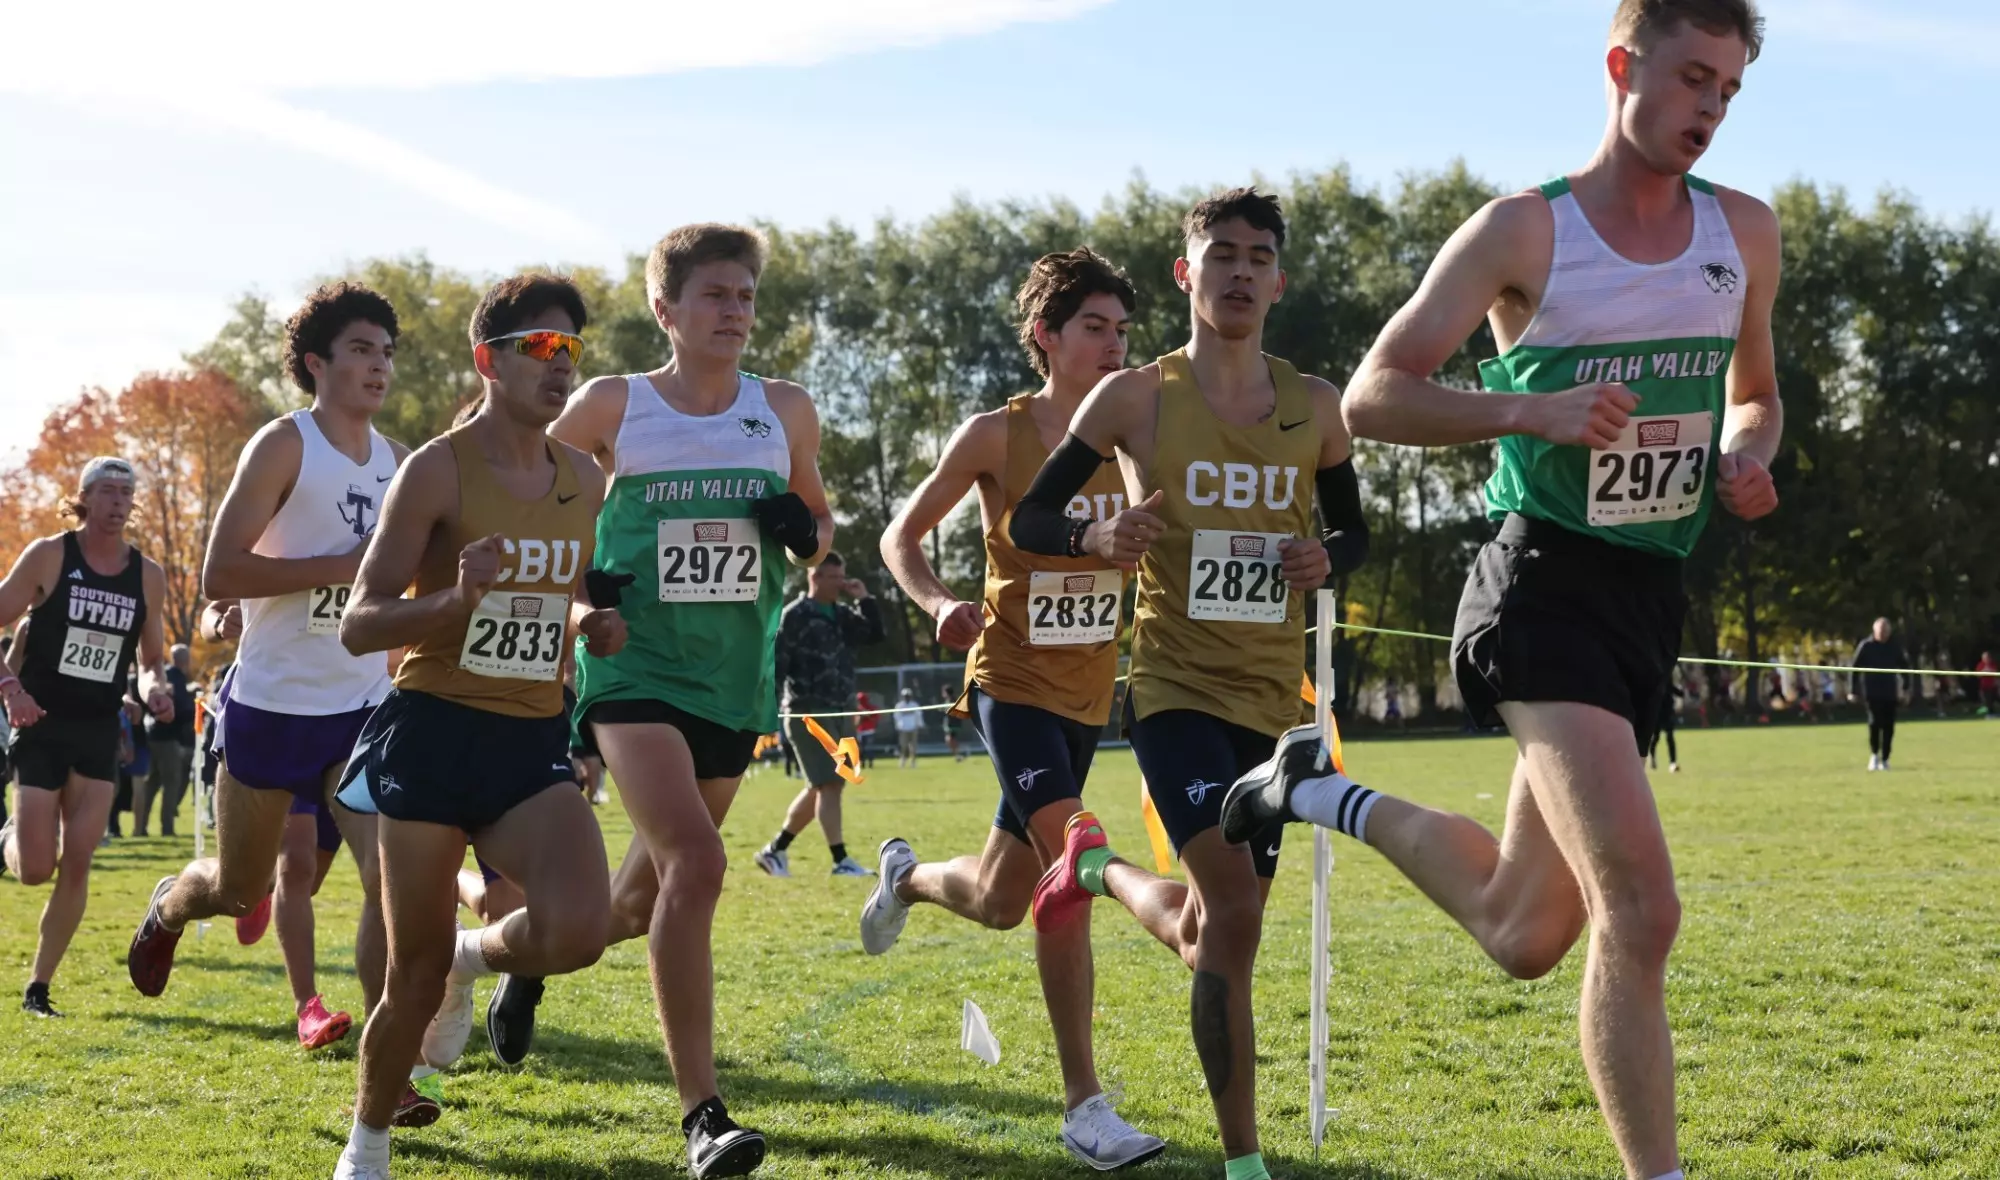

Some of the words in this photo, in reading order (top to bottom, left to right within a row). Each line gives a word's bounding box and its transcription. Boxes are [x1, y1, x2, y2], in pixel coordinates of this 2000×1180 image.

[1574, 355, 1644, 384] UTAH
[645, 480, 695, 503] UTAH
[701, 478, 766, 499] VALLEY
[1185, 460, 1298, 510] CBU
[1595, 446, 1705, 502] 2973
[1065, 493, 1124, 522] BU
[663, 545, 758, 585] 2972
[1194, 558, 1287, 605] 2828
[68, 597, 136, 632] UTAH
[70, 584, 137, 610] SOUTHERN
[312, 585, 352, 620] 29
[1033, 593, 1118, 628] 2832
[63, 642, 117, 672] 2887
[468, 617, 562, 663] 2833
